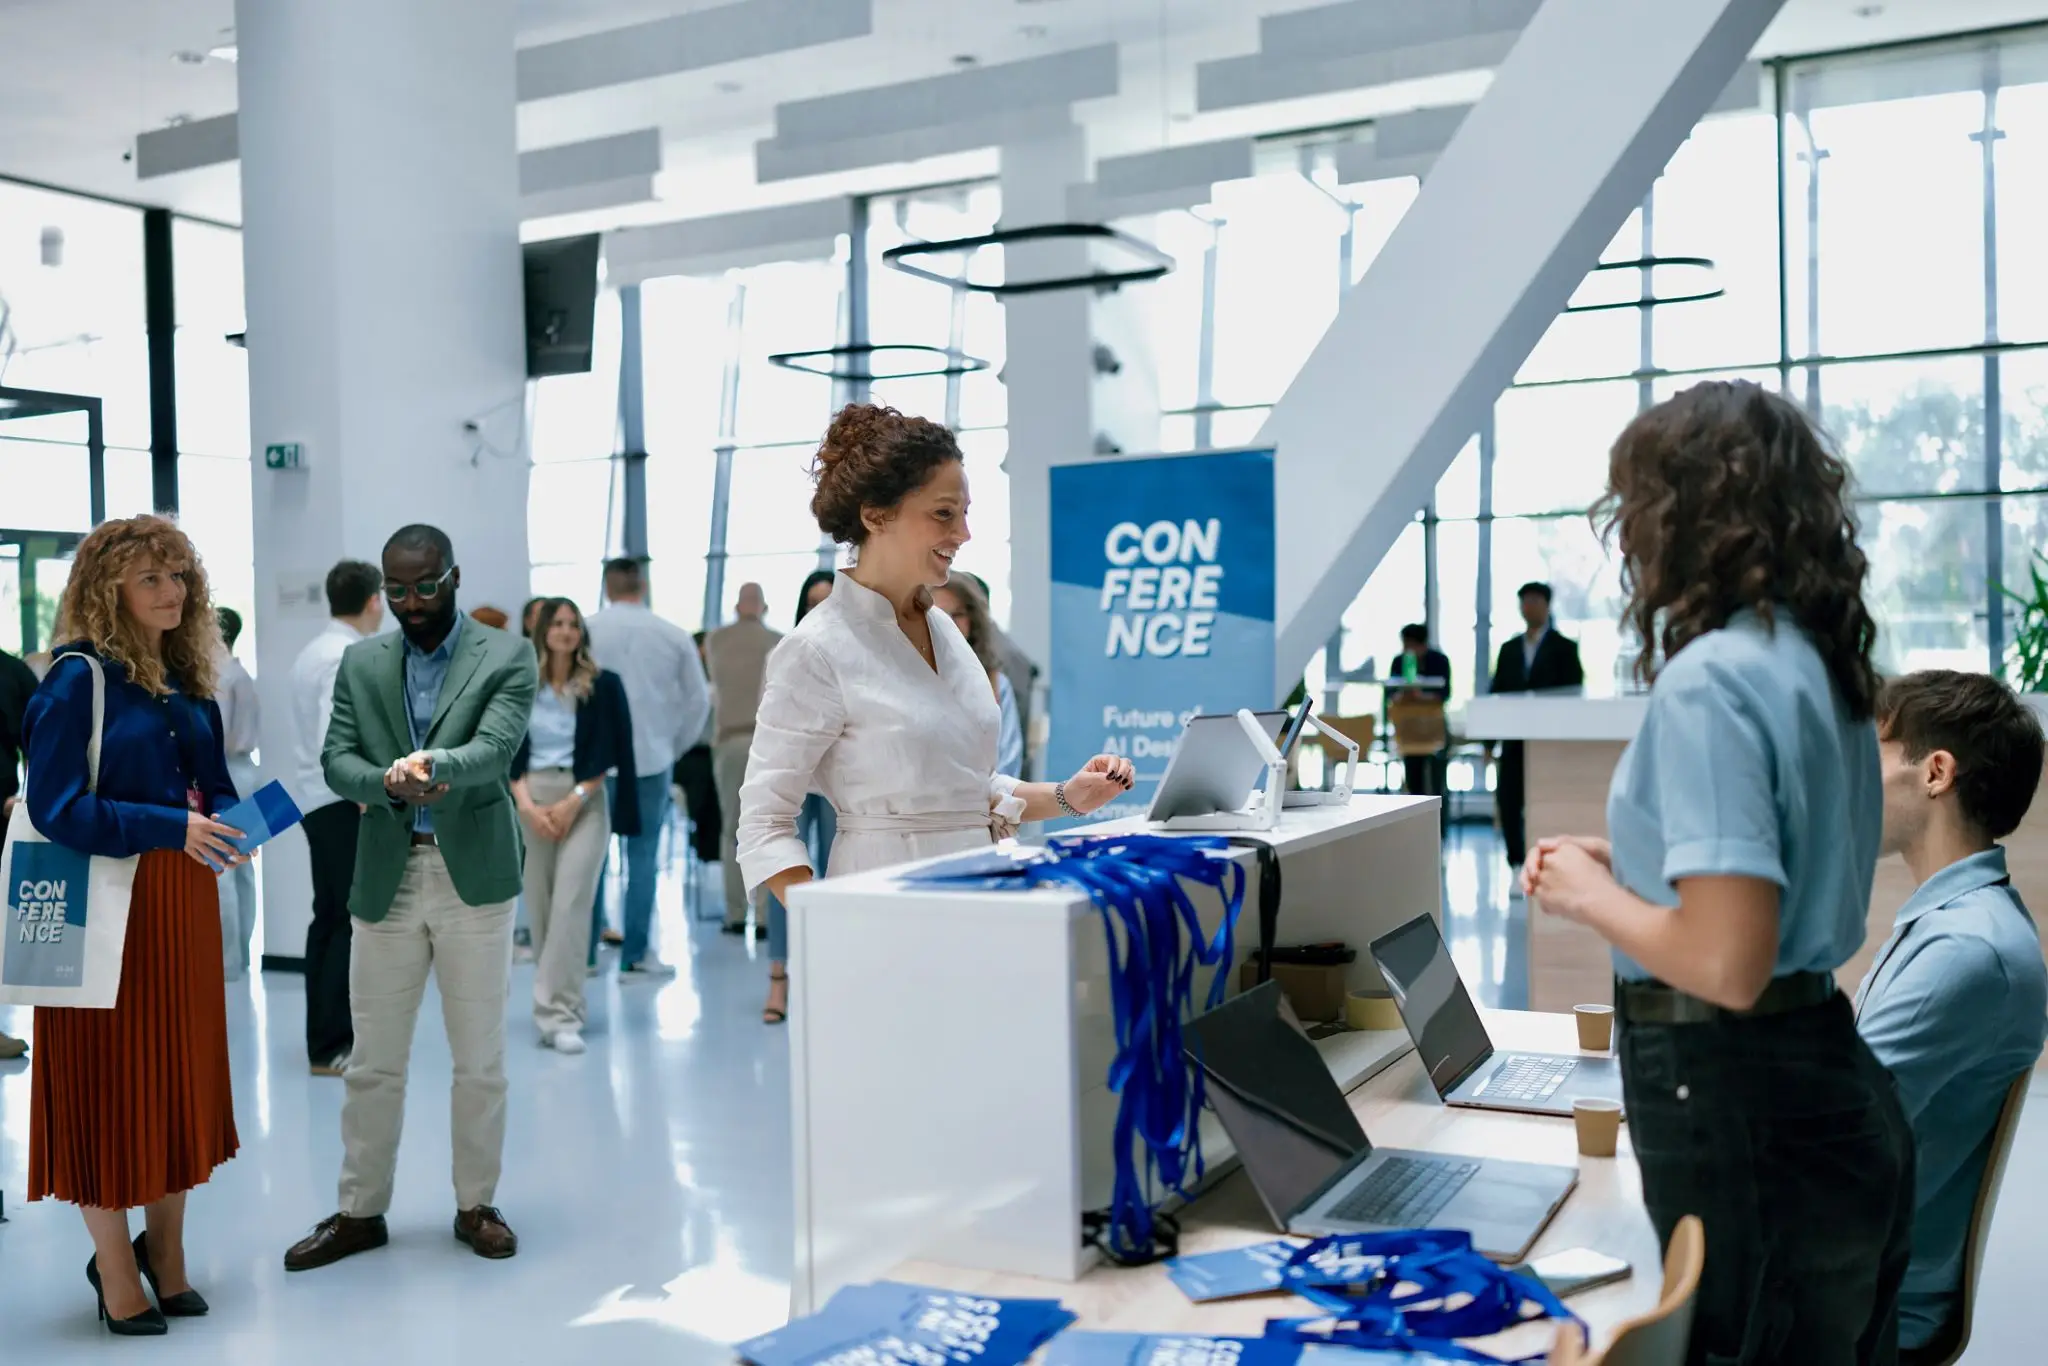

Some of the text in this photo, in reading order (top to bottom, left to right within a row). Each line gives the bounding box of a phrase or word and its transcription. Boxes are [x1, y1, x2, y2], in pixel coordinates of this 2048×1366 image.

[1104, 518, 1221, 566] CON
[1101, 565, 1224, 611] FERE
[1105, 612, 1215, 658] NCE
[1103, 705, 1174, 728] Future
[1102, 736, 1127, 756] AI
[19, 880, 67, 901] CON
[17, 901, 67, 921] FERE
[20, 922, 64, 943] NCE
